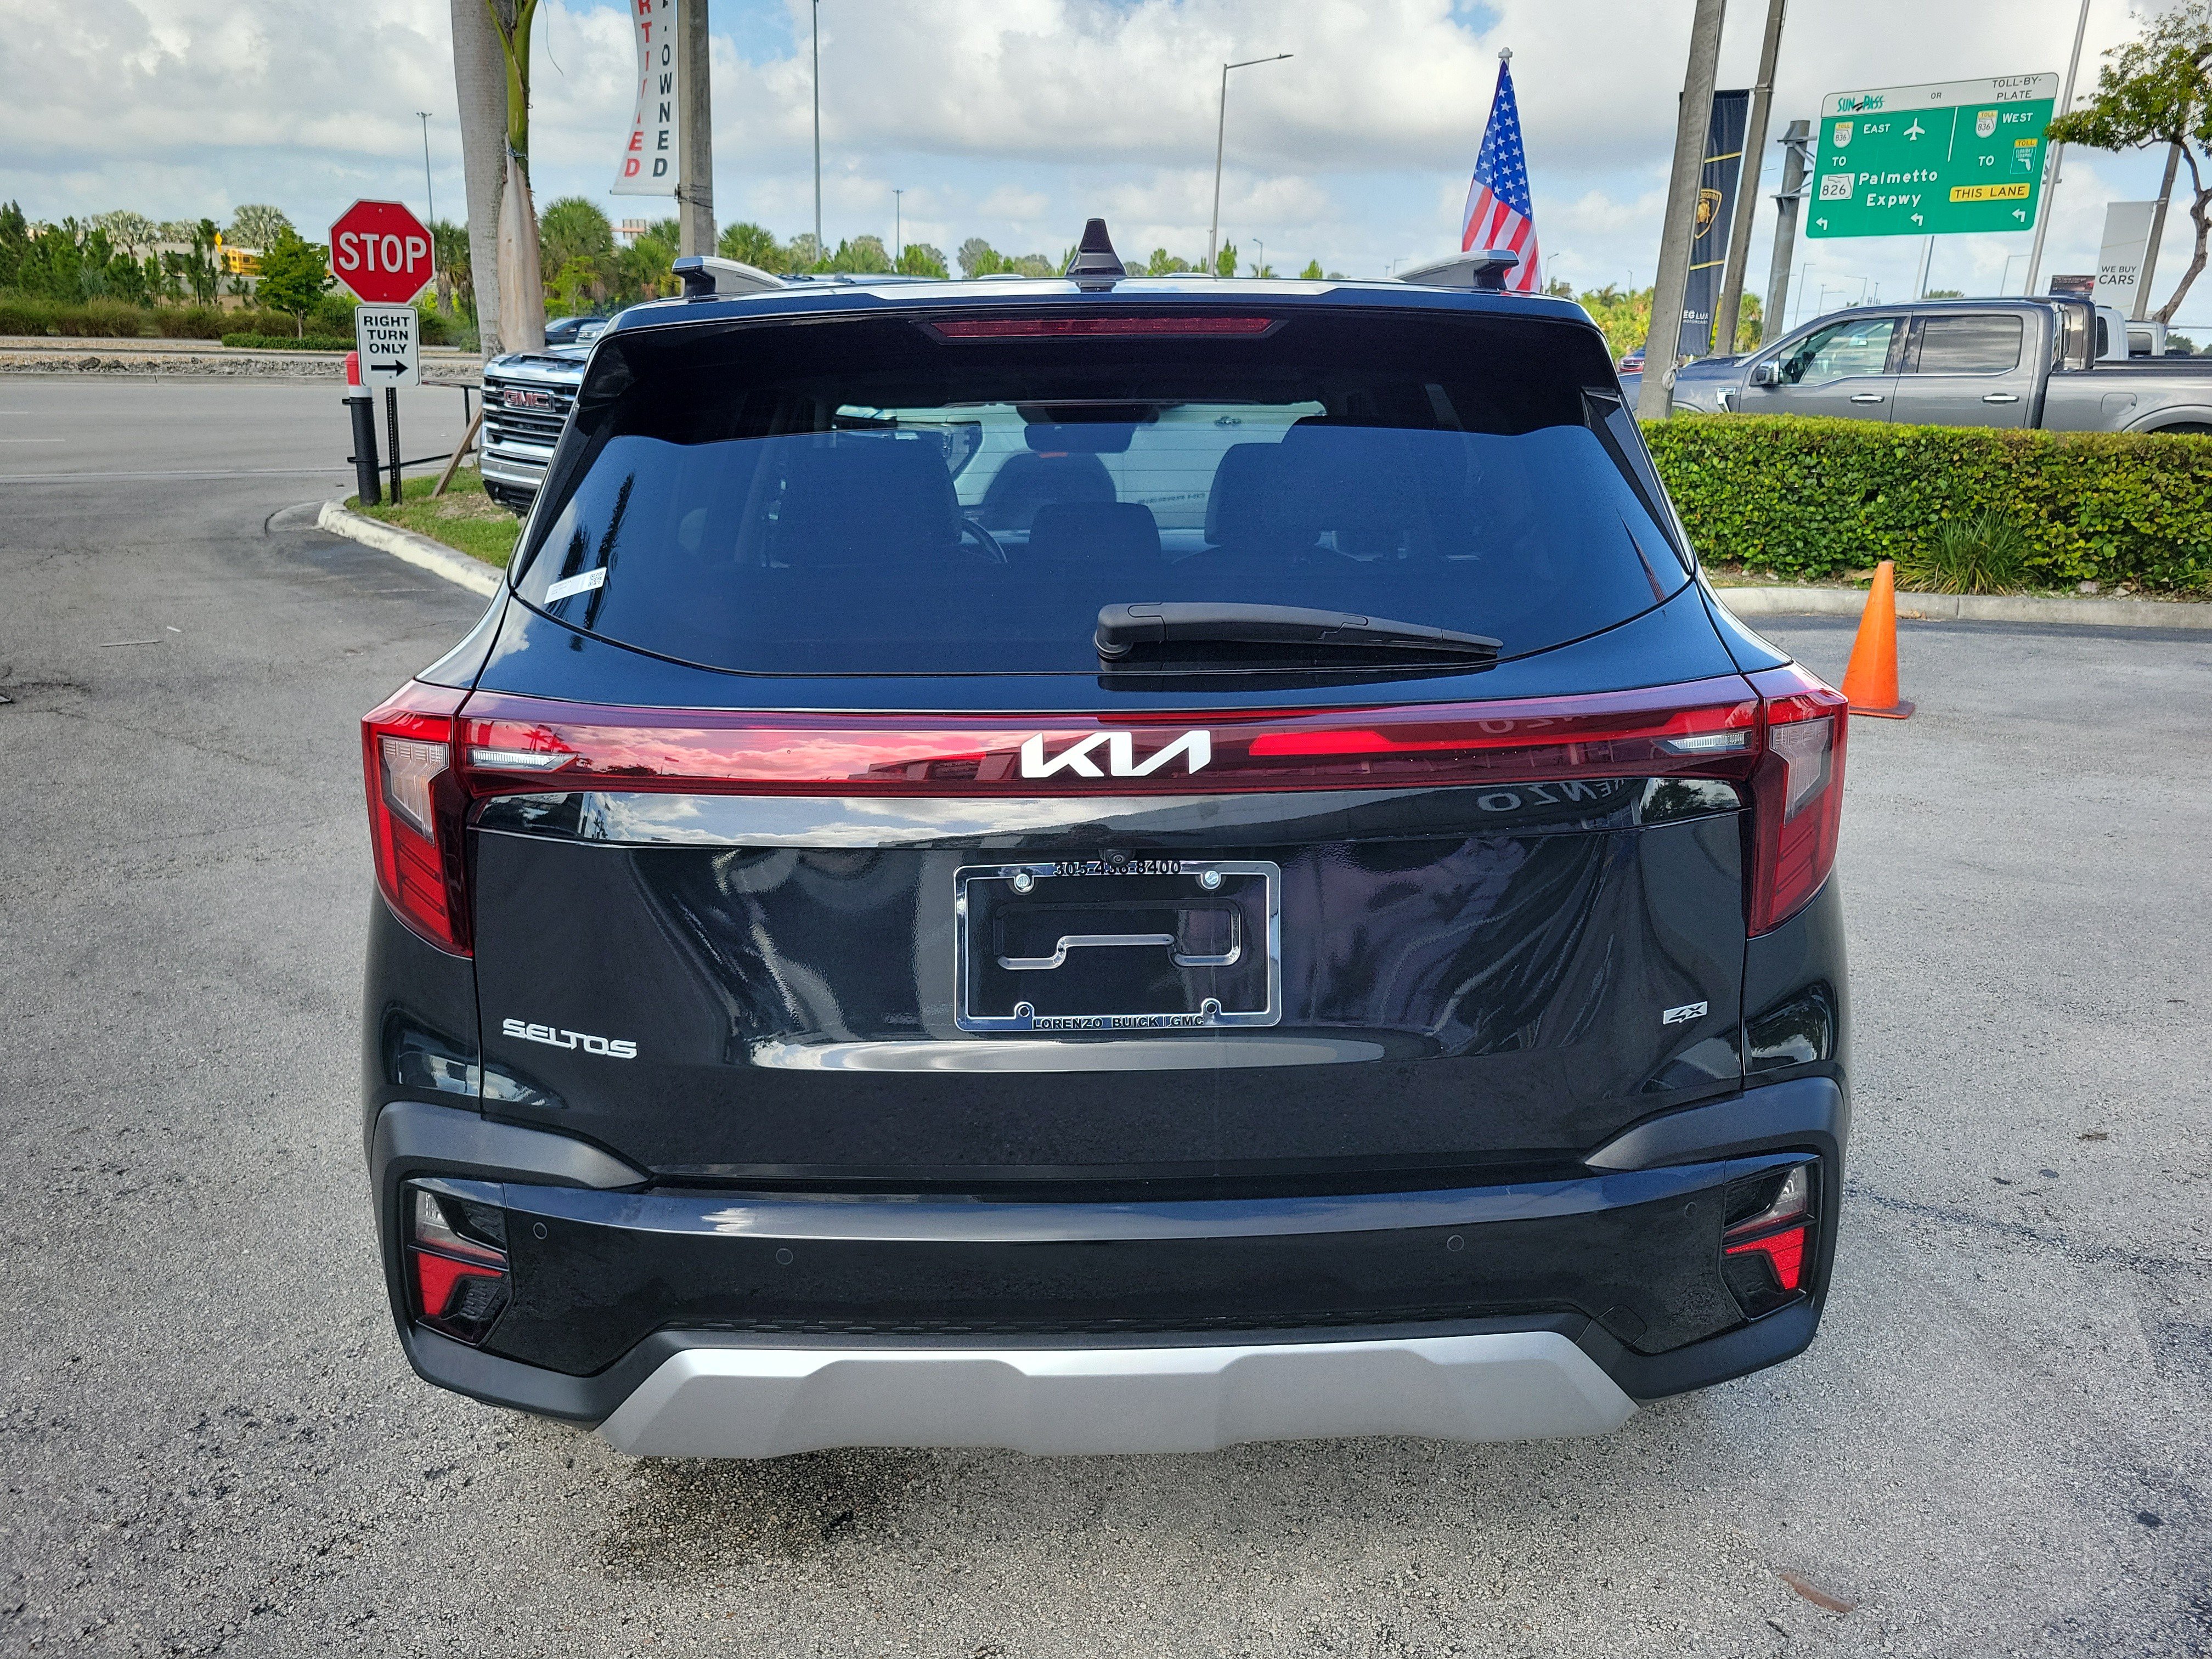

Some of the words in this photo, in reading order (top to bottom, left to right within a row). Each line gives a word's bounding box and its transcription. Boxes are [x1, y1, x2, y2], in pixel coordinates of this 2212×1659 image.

[1993, 76, 2042, 88] TOLL-BY-
[1996, 90, 2032, 101] PLATE
[2002, 112, 2034, 123] WEST
[1863, 123, 1891, 134] EAST
[1832, 156, 1847, 167] TO
[1978, 155, 1995, 167] TO
[1859, 168, 1938, 185] Palmetto
[1822, 184, 1846, 196] 826
[1955, 189, 1983, 199] THIS
[1990, 186, 2026, 198] LANE
[1866, 193, 1921, 208] Expwy
[338, 231, 427, 273] STOP
[2098, 275, 2135, 285] CARS
[363, 315, 410, 327] RIGHT
[367, 330, 408, 341] TURN
[369, 343, 408, 354] ONLY
[504, 390, 549, 407] GMC
[1021, 730, 1211, 778] KIA
[1032, 1017, 1103, 1029] LORENZO
[1111, 1016, 1160, 1028] BUICK
[1169, 1015, 1205, 1027] GMC
[503, 1018, 637, 1059] SELTOS
